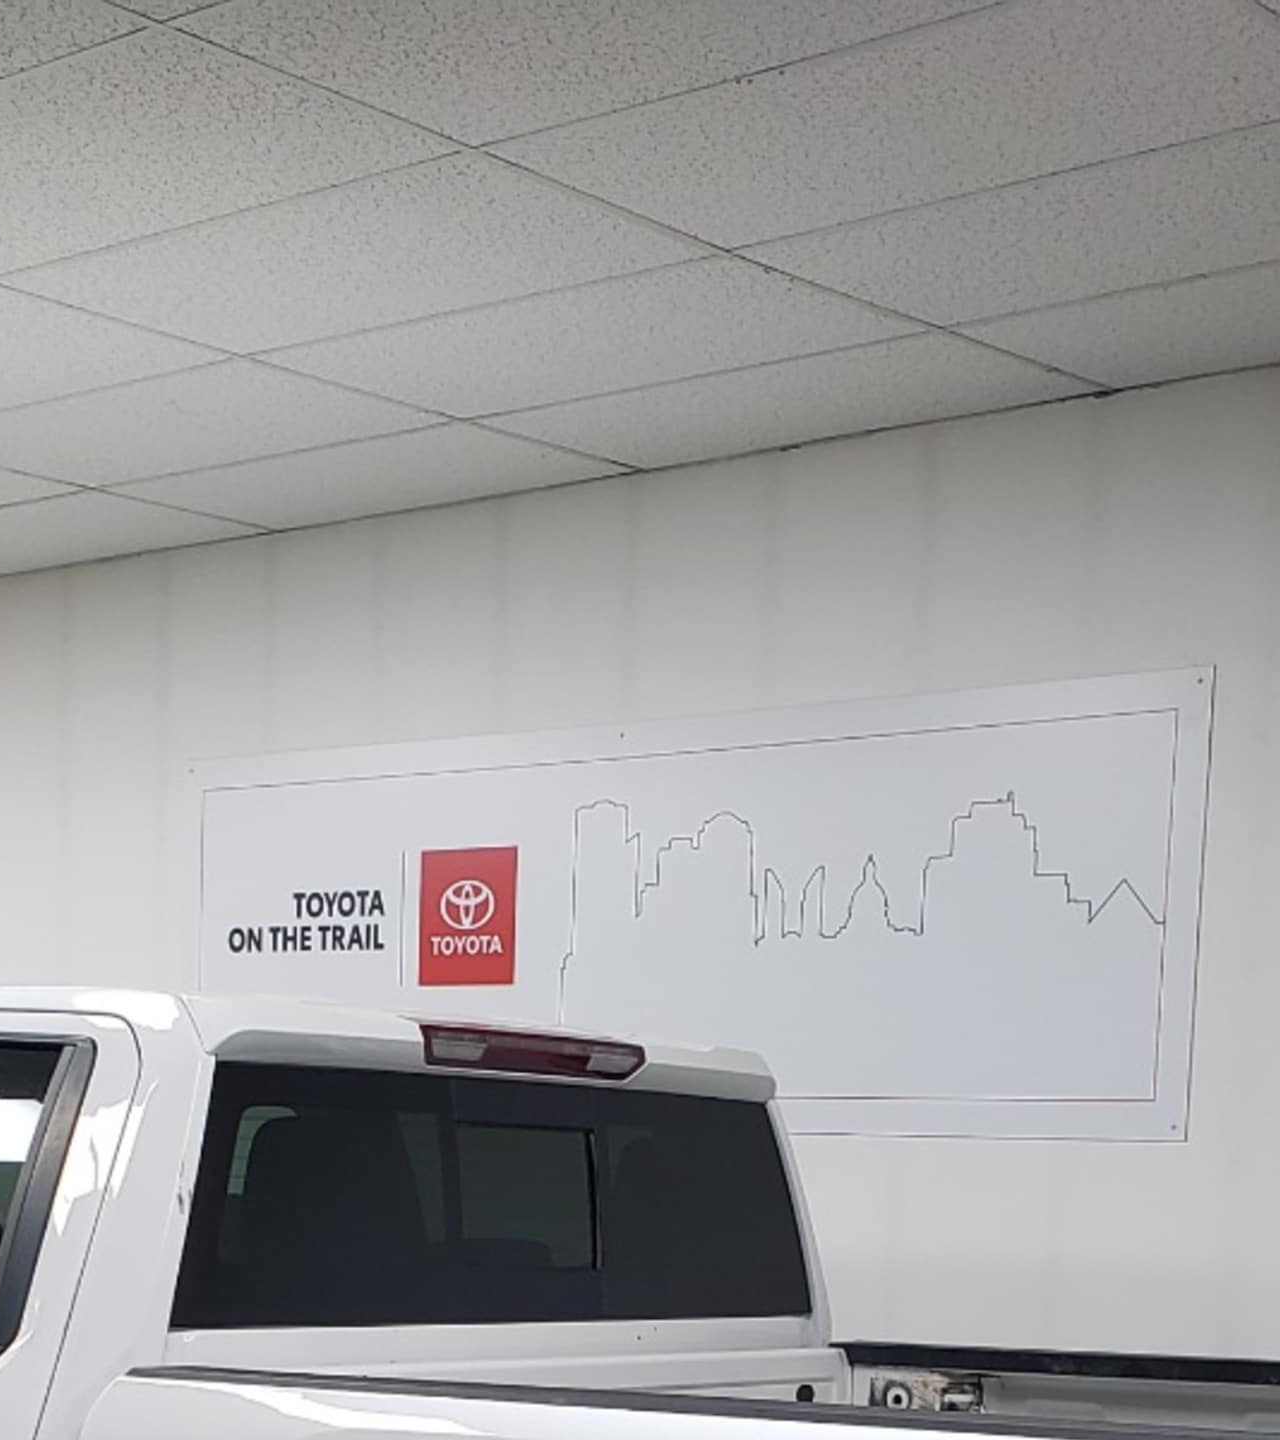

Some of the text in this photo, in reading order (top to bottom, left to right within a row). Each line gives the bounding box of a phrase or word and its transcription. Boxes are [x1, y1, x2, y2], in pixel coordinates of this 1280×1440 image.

[293, 890, 385, 919] TOYOTA
[228, 923, 385, 952] ON THE TRAIL
[430, 935, 503, 956] TOYOTA
